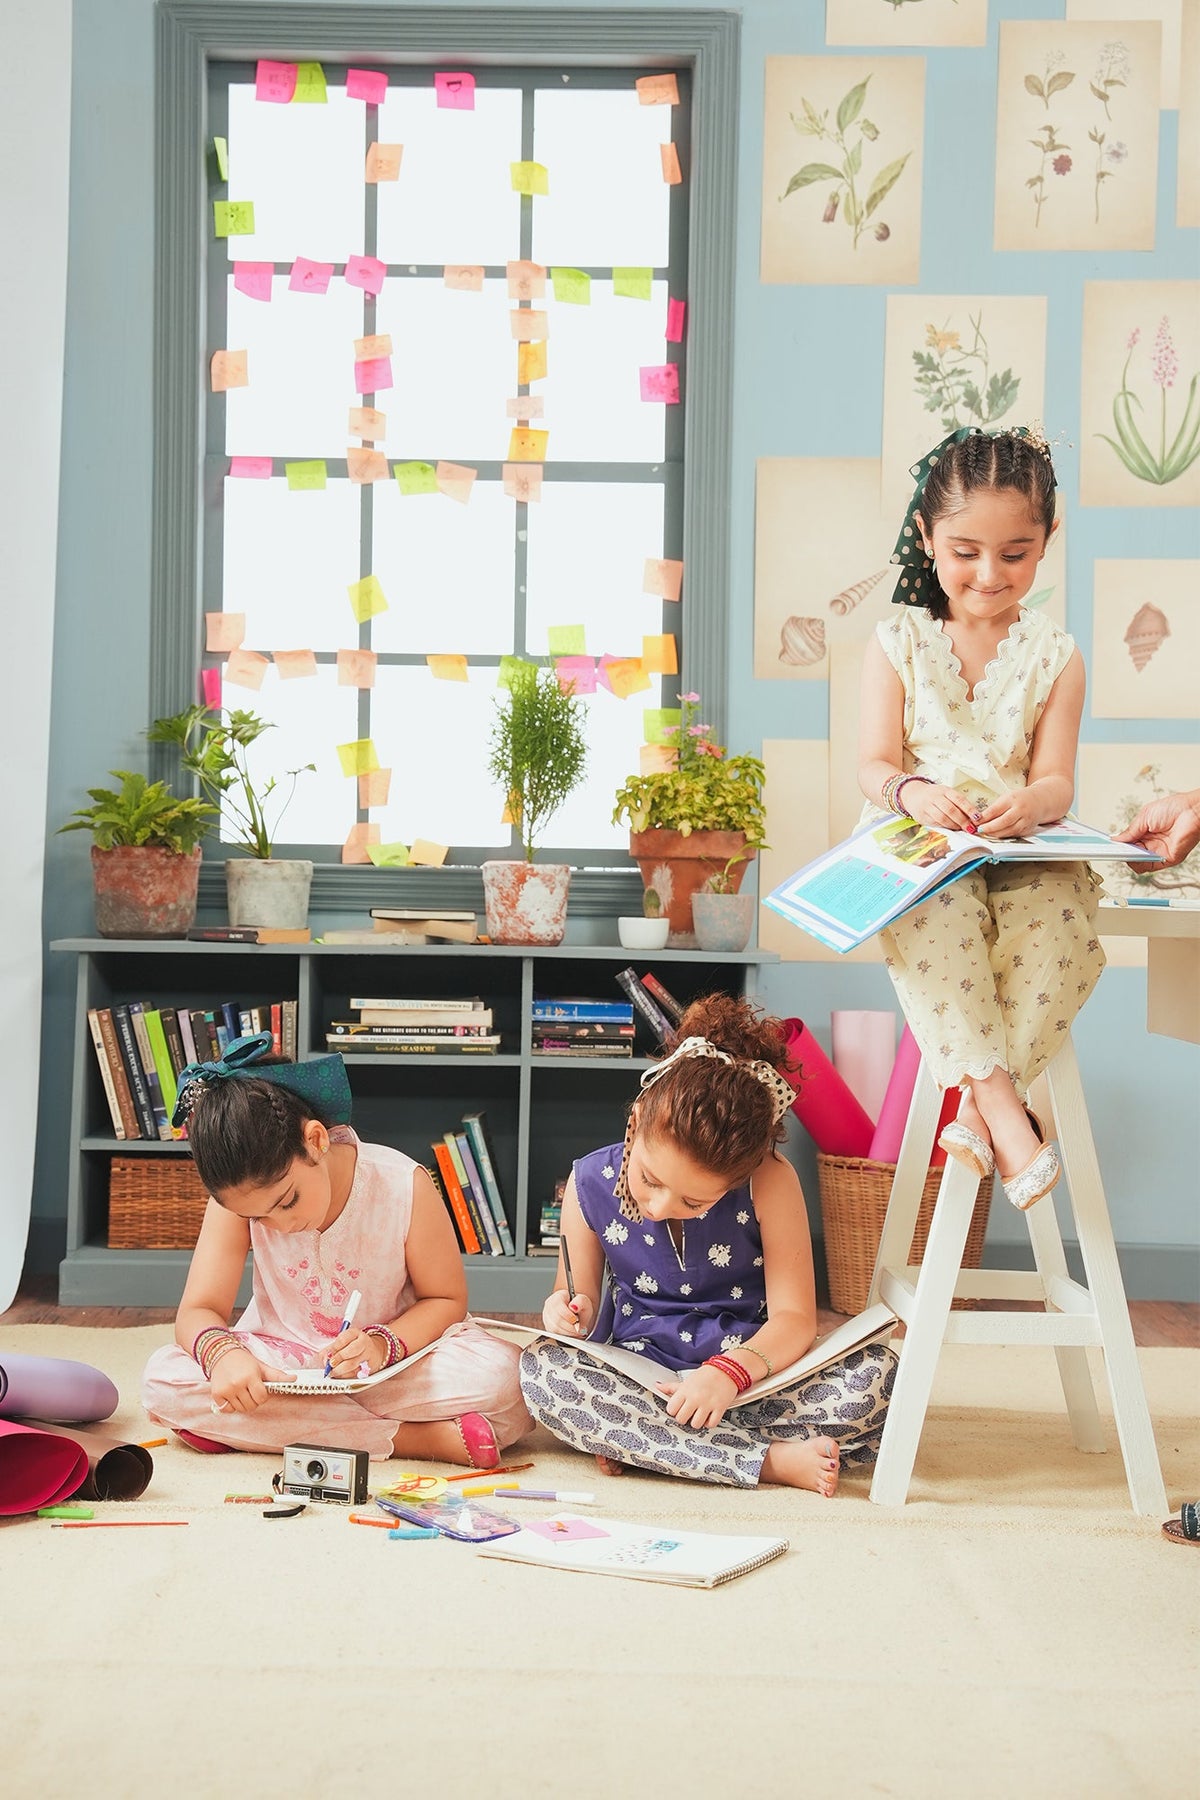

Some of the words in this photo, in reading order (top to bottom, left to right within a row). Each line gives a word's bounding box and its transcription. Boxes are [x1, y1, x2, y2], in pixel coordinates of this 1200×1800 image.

[120, 1023, 133, 1052] FEDERAL
[127, 1052, 139, 1076] EXCISE
[401, 1045, 436, 1053] SEASHORE
